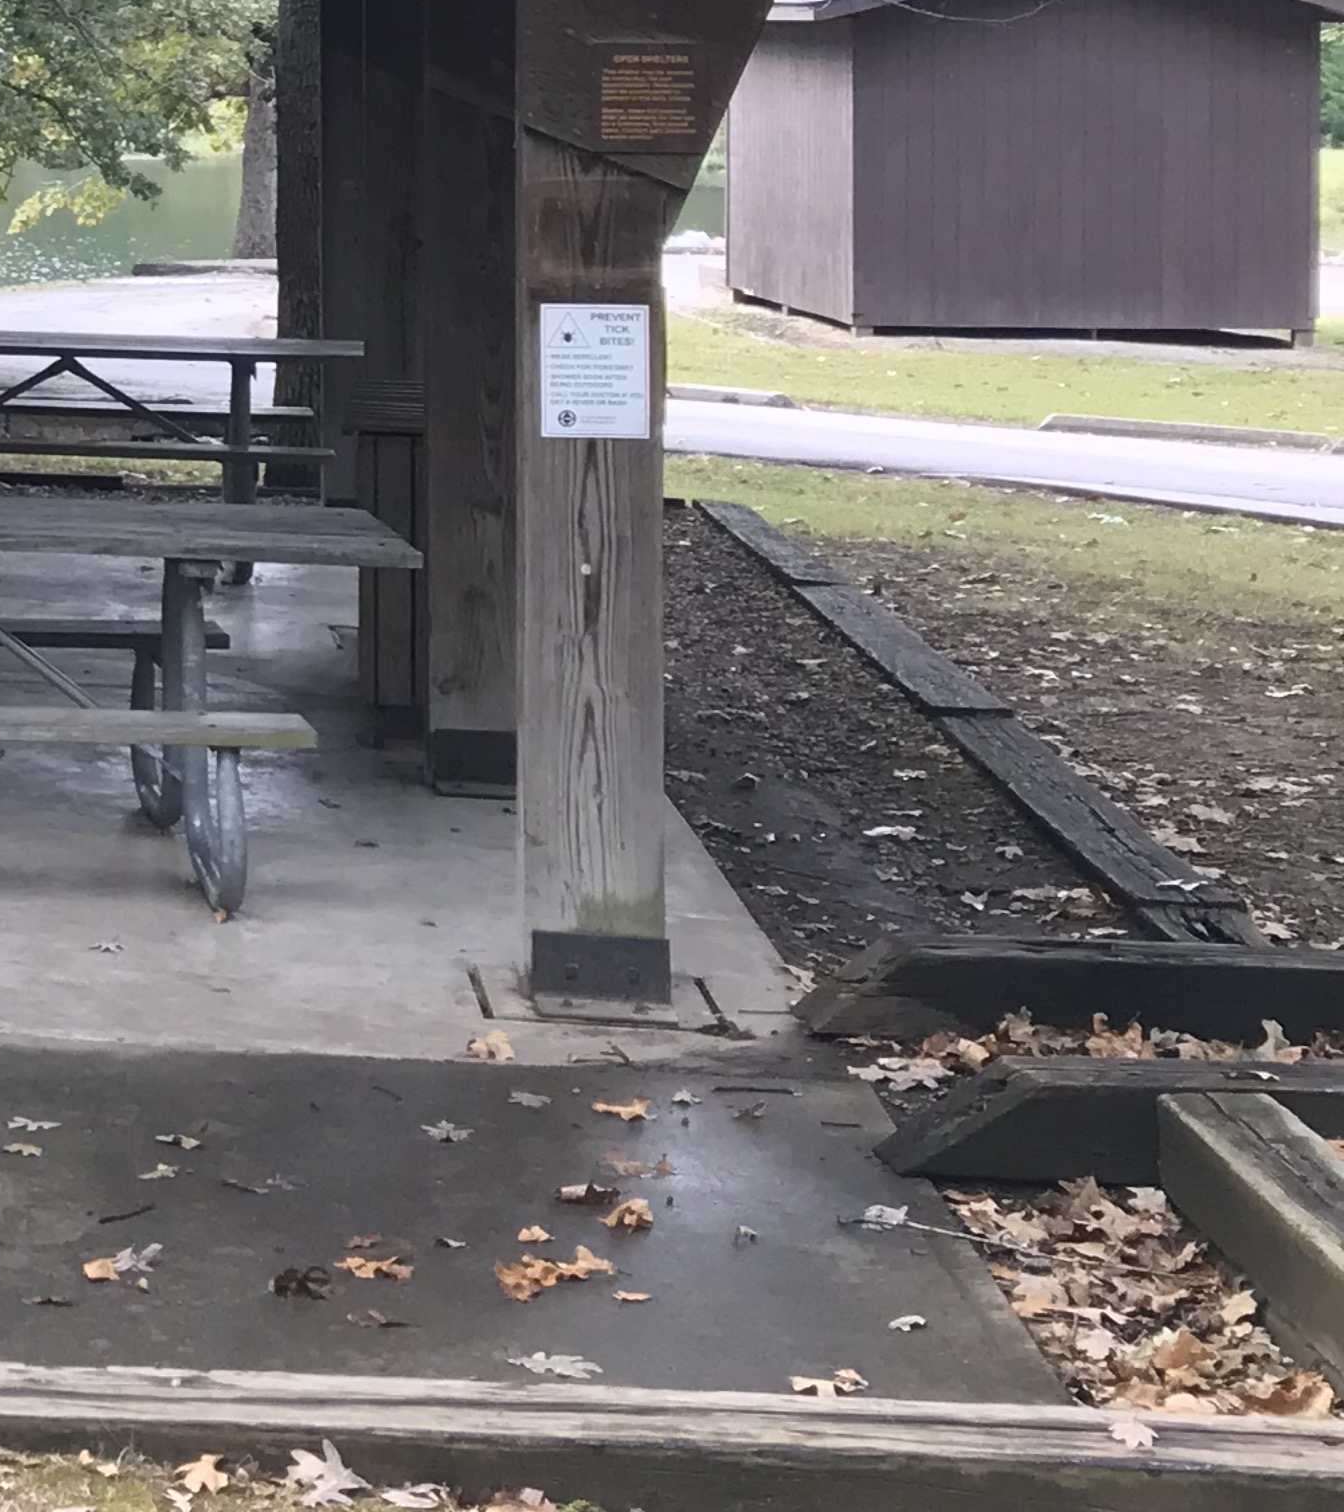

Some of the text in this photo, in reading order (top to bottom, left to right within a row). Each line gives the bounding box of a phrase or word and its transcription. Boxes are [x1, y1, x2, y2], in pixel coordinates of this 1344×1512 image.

[613, 54, 689, 64] OPEN SHELTERS
[590, 312, 641, 322] PREVENT
[604, 324, 630, 334] TICK
[599, 336, 635, 346] BITES!
